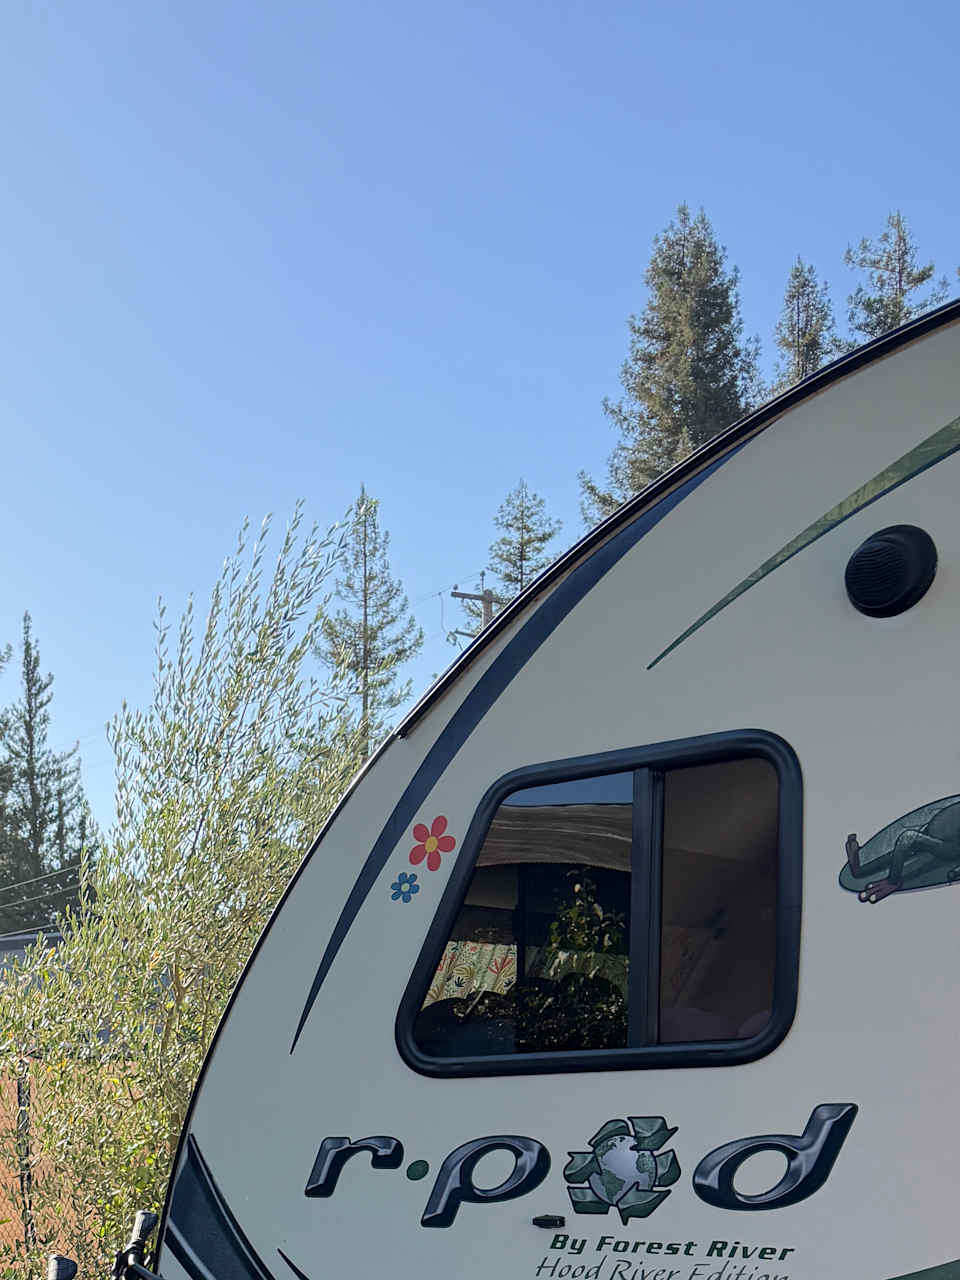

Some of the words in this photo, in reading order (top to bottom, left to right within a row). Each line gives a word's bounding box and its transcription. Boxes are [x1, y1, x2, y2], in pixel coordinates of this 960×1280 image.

[549, 1233, 587, 1255] By
[595, 1236, 698, 1256] Forest
[705, 1240, 795, 1261] River
[535, 1254, 608, 1280] Hood
